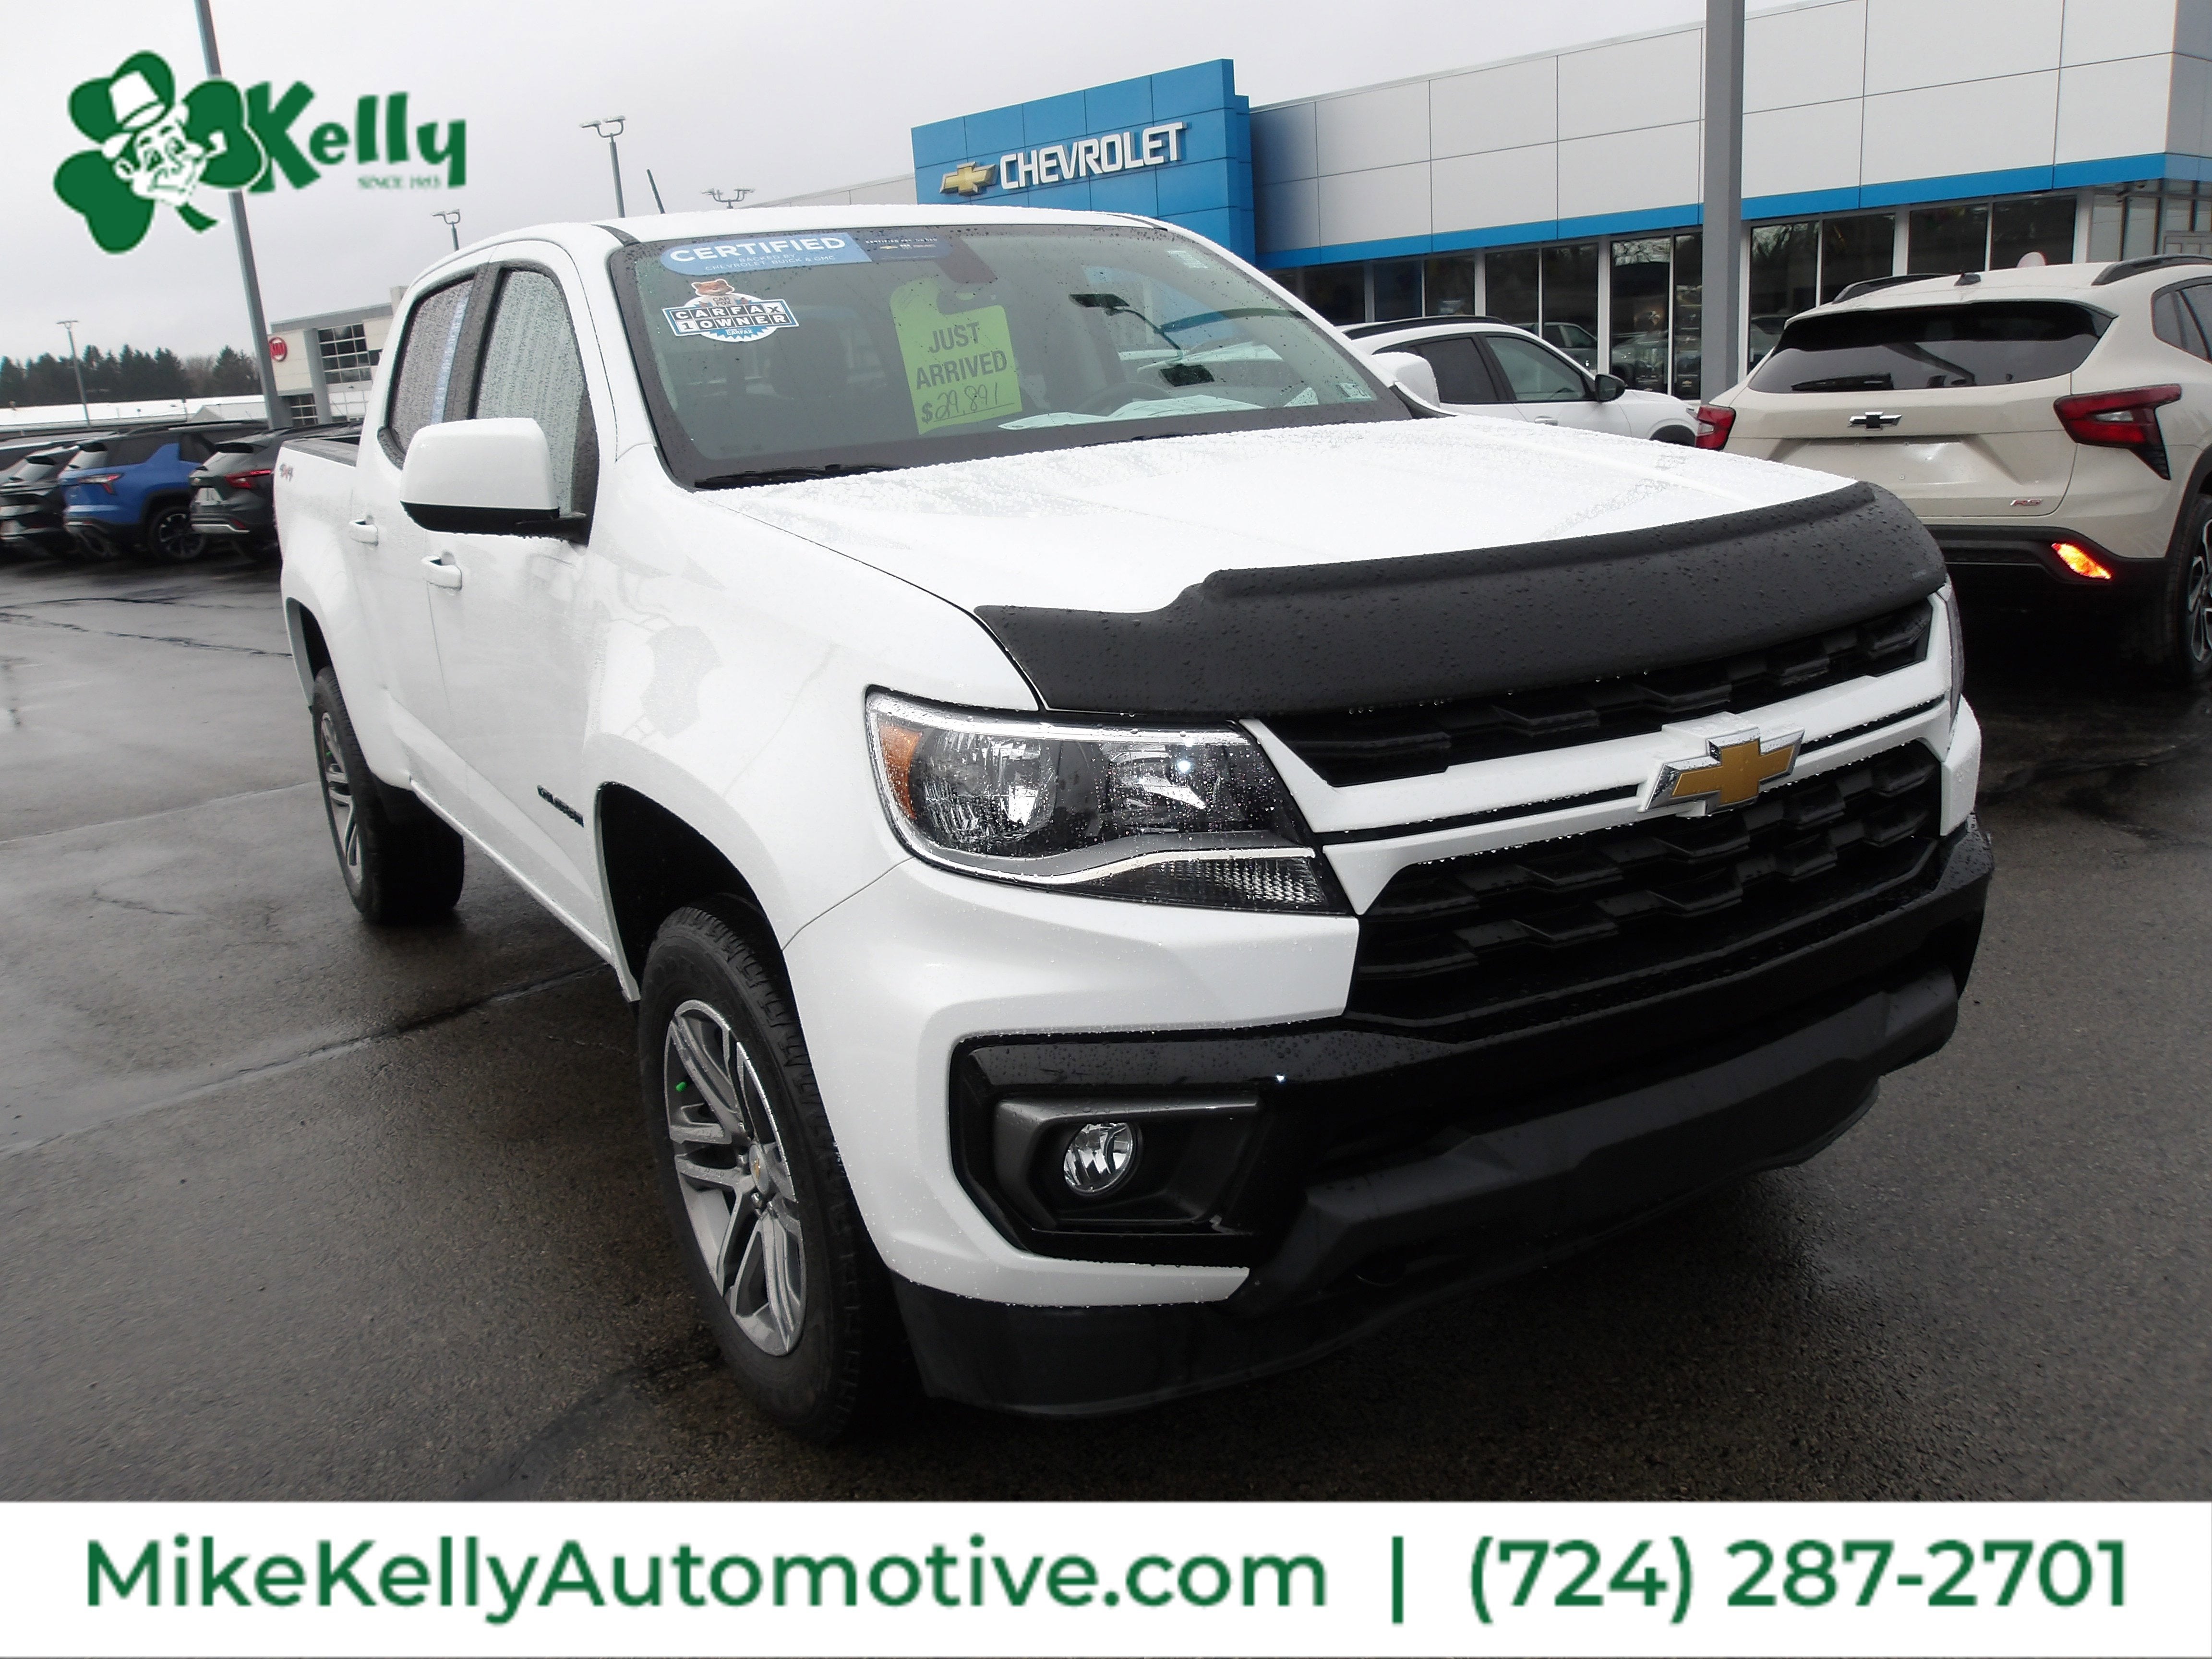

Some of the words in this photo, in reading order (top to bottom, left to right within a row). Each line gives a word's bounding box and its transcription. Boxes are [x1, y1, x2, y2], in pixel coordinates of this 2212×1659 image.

[1000, 121, 1187, 190] CHEVROLET
[670, 237, 845, 262] CERTIFIED
[675, 305, 779, 320] CARFAX
[929, 321, 980, 353] JUST
[916, 350, 1007, 390] ARRIVED
